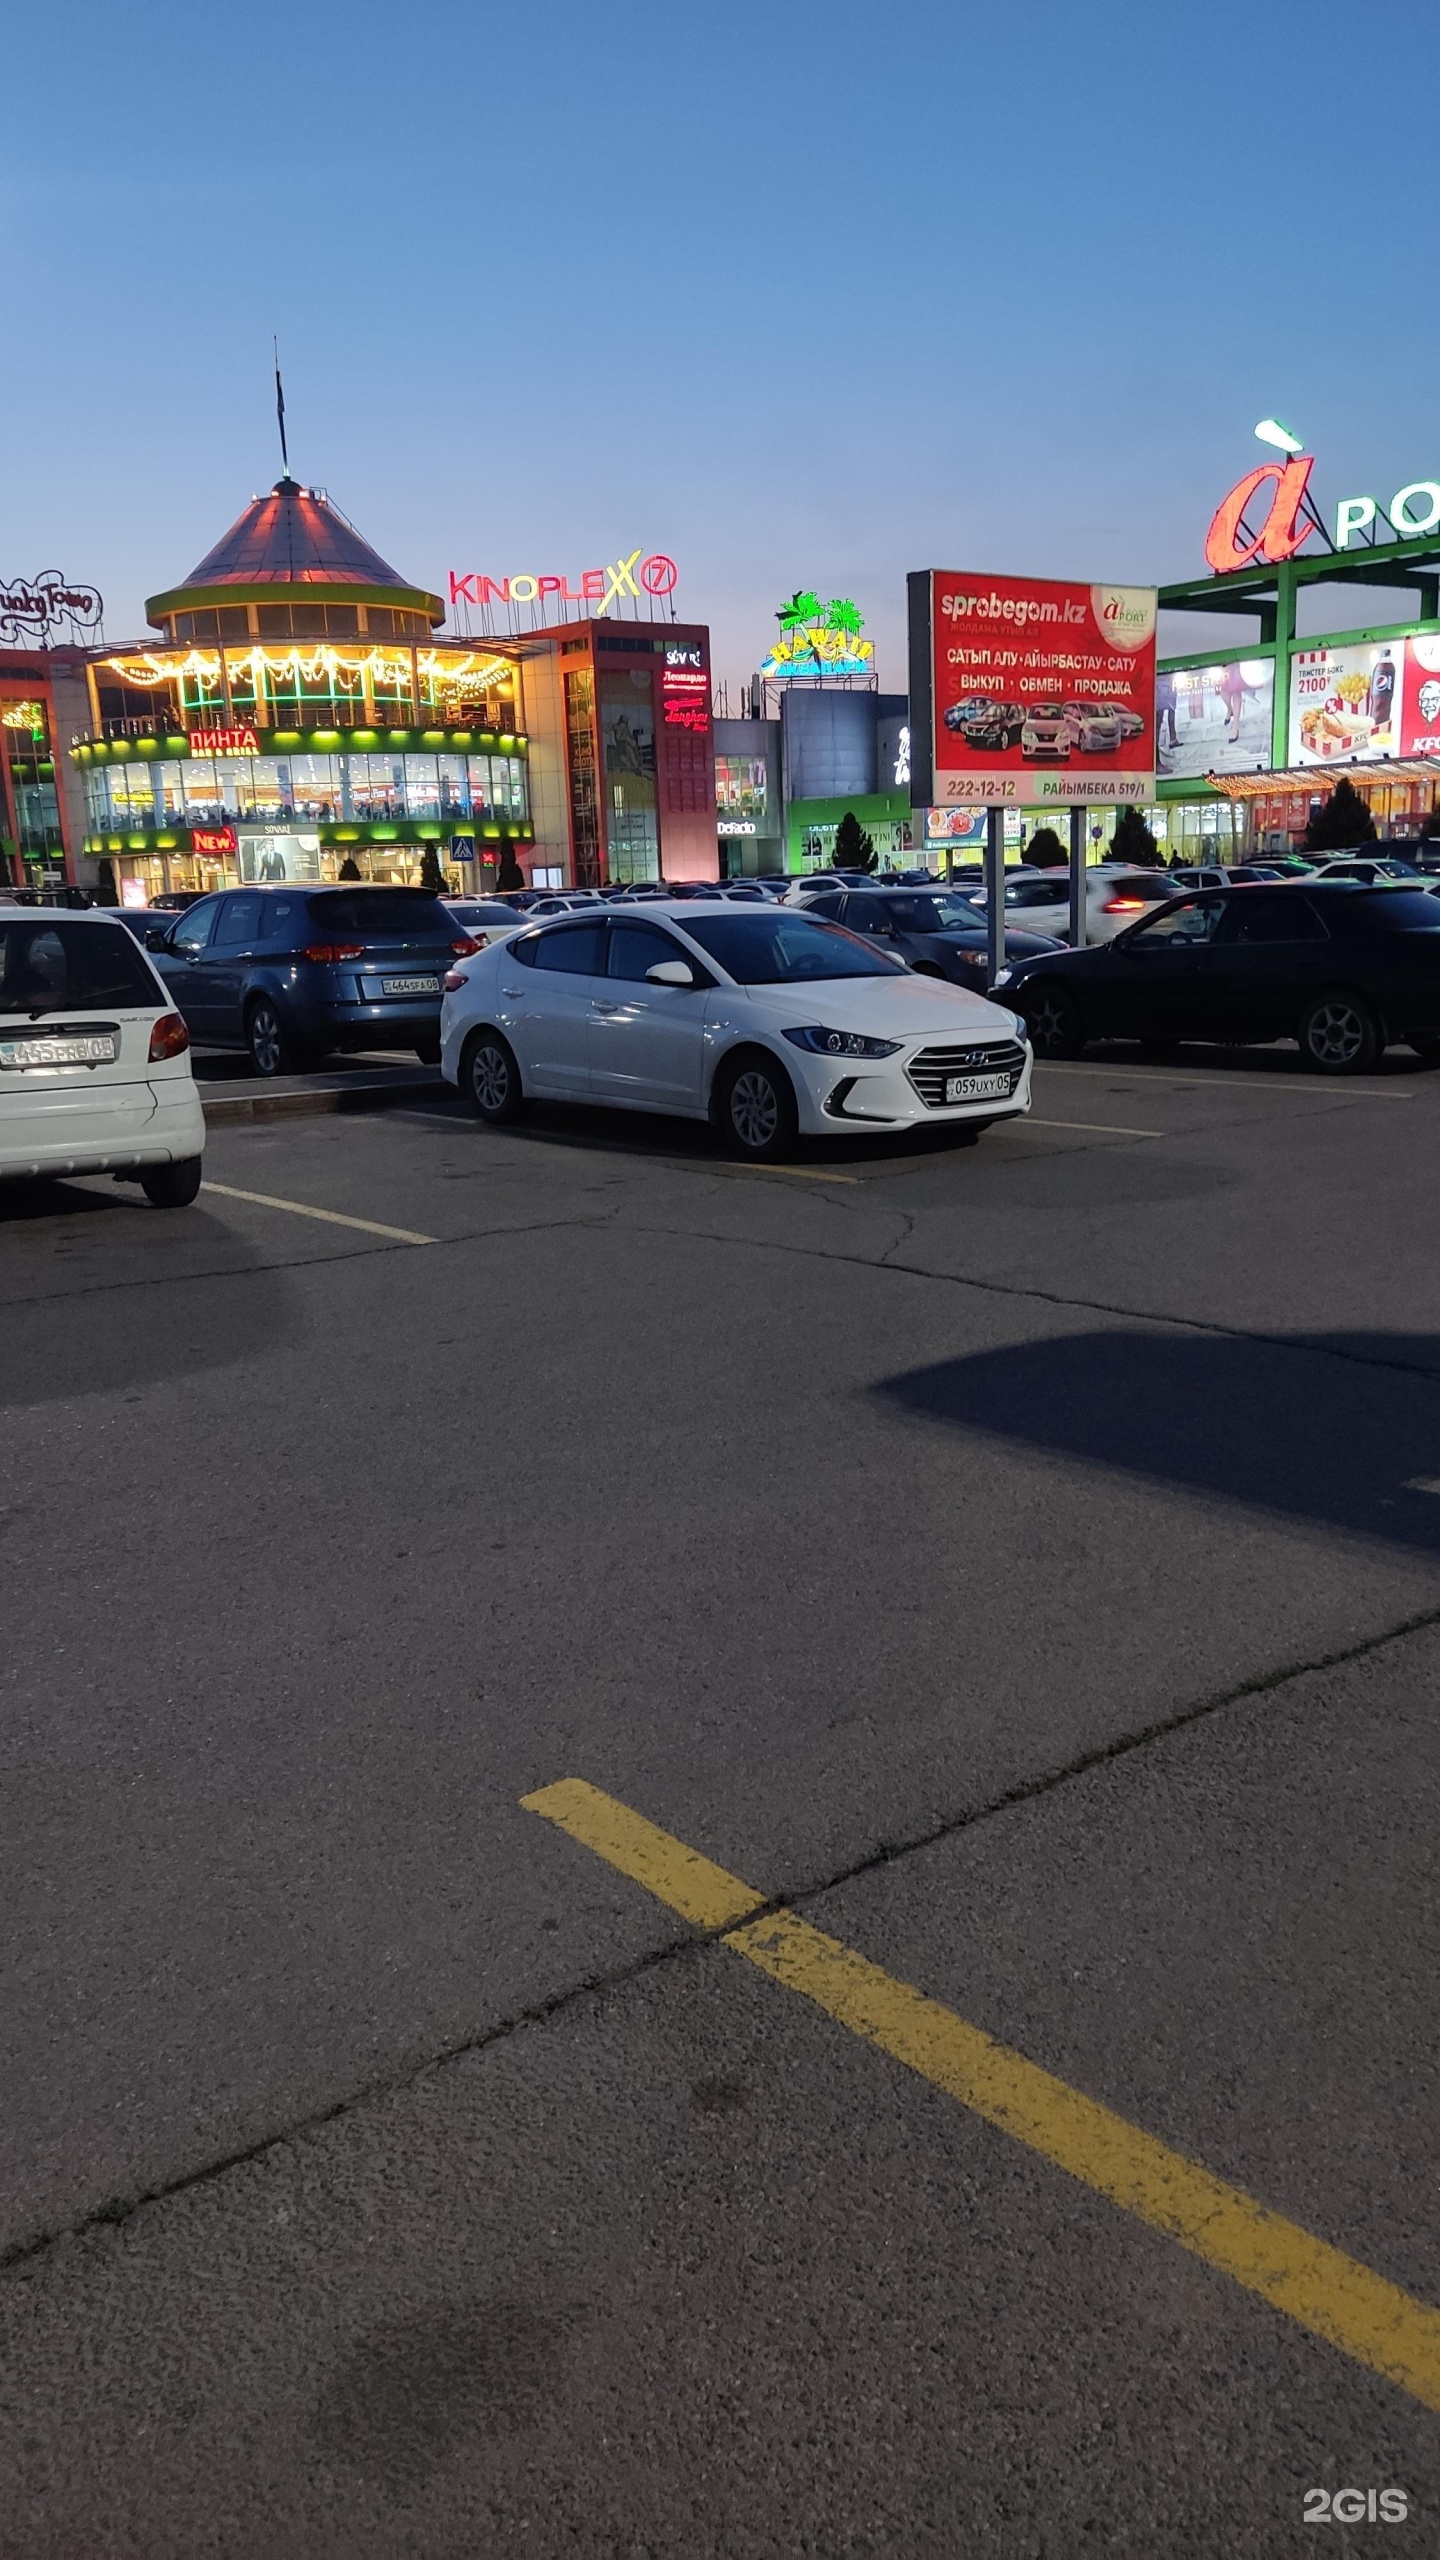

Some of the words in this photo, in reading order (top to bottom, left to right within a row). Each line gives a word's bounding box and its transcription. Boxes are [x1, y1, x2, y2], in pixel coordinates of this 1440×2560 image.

[1206, 419, 1440, 571] àPO
[449, 549, 643, 615] KINOPLEXX
[940, 592, 1087, 626] sprobegom.kz
[769, 628, 874, 664] HAWAII
[947, 648, 991, 665] САТЫП
[993, 651, 1018, 667] АЛУ
[1024, 648, 1102, 670] АЙЫРБАСТАУ
[1107, 656, 1136, 672] САТУ
[663, 671, 707, 684] Леонардо
[1298, 667, 1326, 678] ТВИСТЕР
[961, 673, 1004, 691] ВЫКУП
[1019, 677, 1063, 693] ОБМЕН
[1074, 679, 1132, 696] ПРОДАЖА
[190, 730, 257, 748] ПИНТА
[947, 780, 1016, 797] 222-12-12
[1043, 779, 1116, 796] РАЙЫМБЕКА
[1118, 782, 1145, 798] 519/1
[193, 827, 235, 851] NEW!
[717, 821, 756, 835] DeFacto
